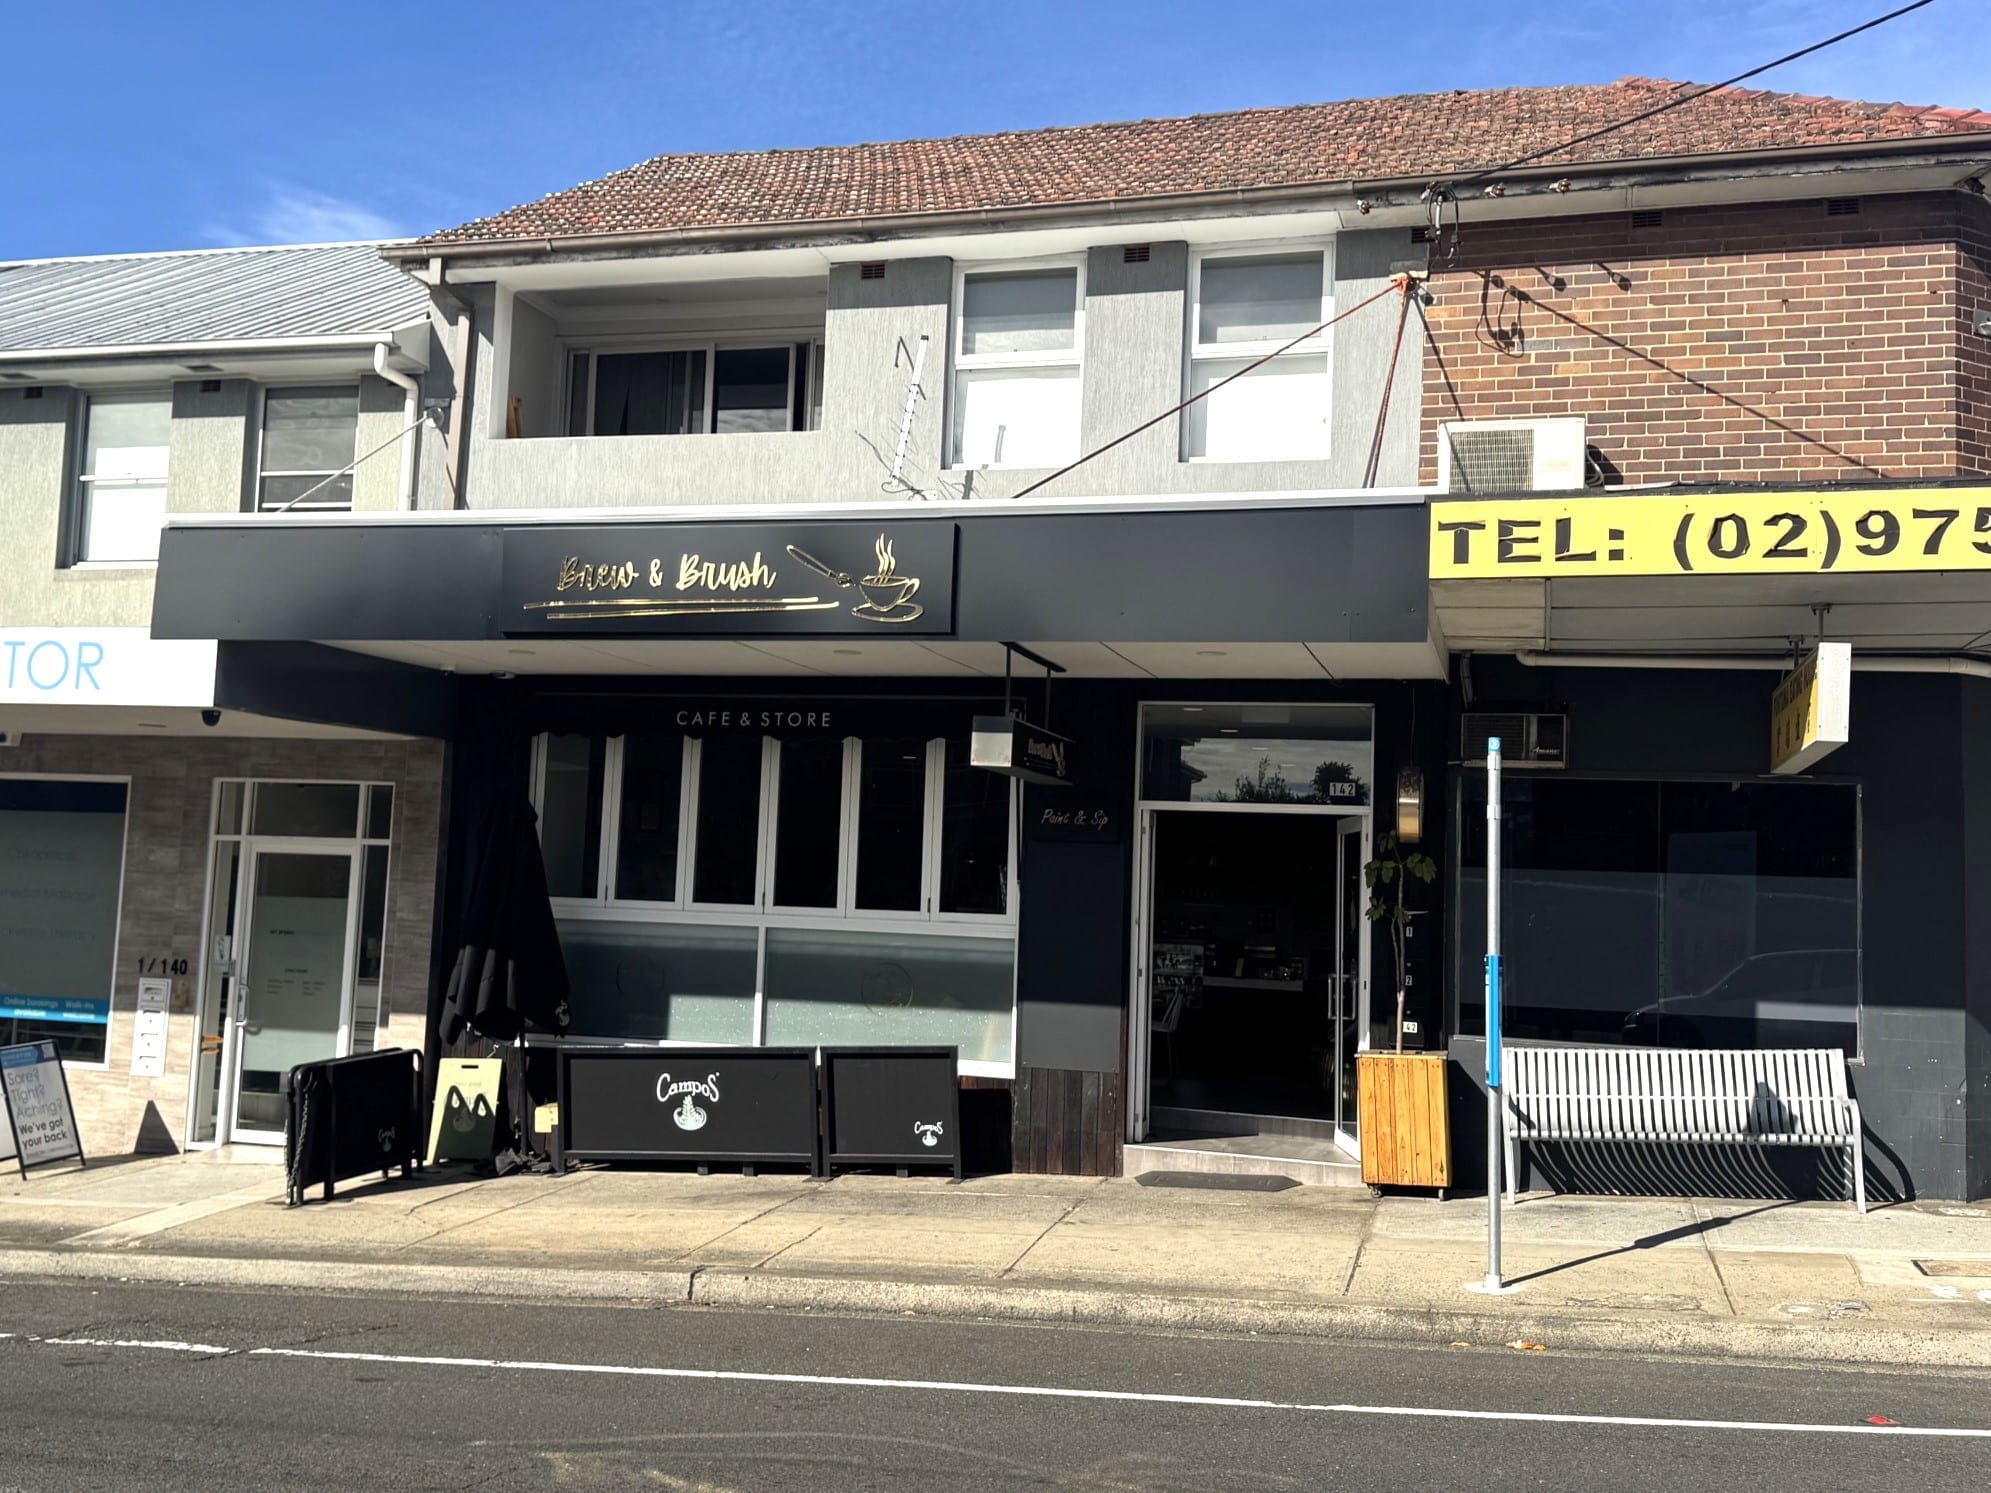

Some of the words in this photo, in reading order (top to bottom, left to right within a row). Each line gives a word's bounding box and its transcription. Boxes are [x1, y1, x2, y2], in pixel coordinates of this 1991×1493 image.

[1437, 516, 1625, 565] TEL:
[557, 555, 640, 592] Brew
[649, 558, 663, 588] &
[676, 552, 777, 592] Brush
[3, 640, 104, 690] TOR
[676, 711, 731, 726] CAFE
[740, 712, 751, 727] &
[760, 712, 831, 727] STORE
[1332, 783, 1354, 796] 142
[1041, 808, 1071, 825] Paint
[1074, 810, 1087, 825] &
[1091, 809, 1109, 832] Sip
[138, 957, 188, 975] 1/140
[7, 1069, 39, 1086] Sore?
[11, 1085, 45, 1104] Tight?
[17, 1099, 63, 1120] Aching?
[19, 1121, 47, 1135] We've
[48, 1118, 64, 1131] got
[22, 1136, 43, 1150] your
[44, 1130, 67, 1143] back
